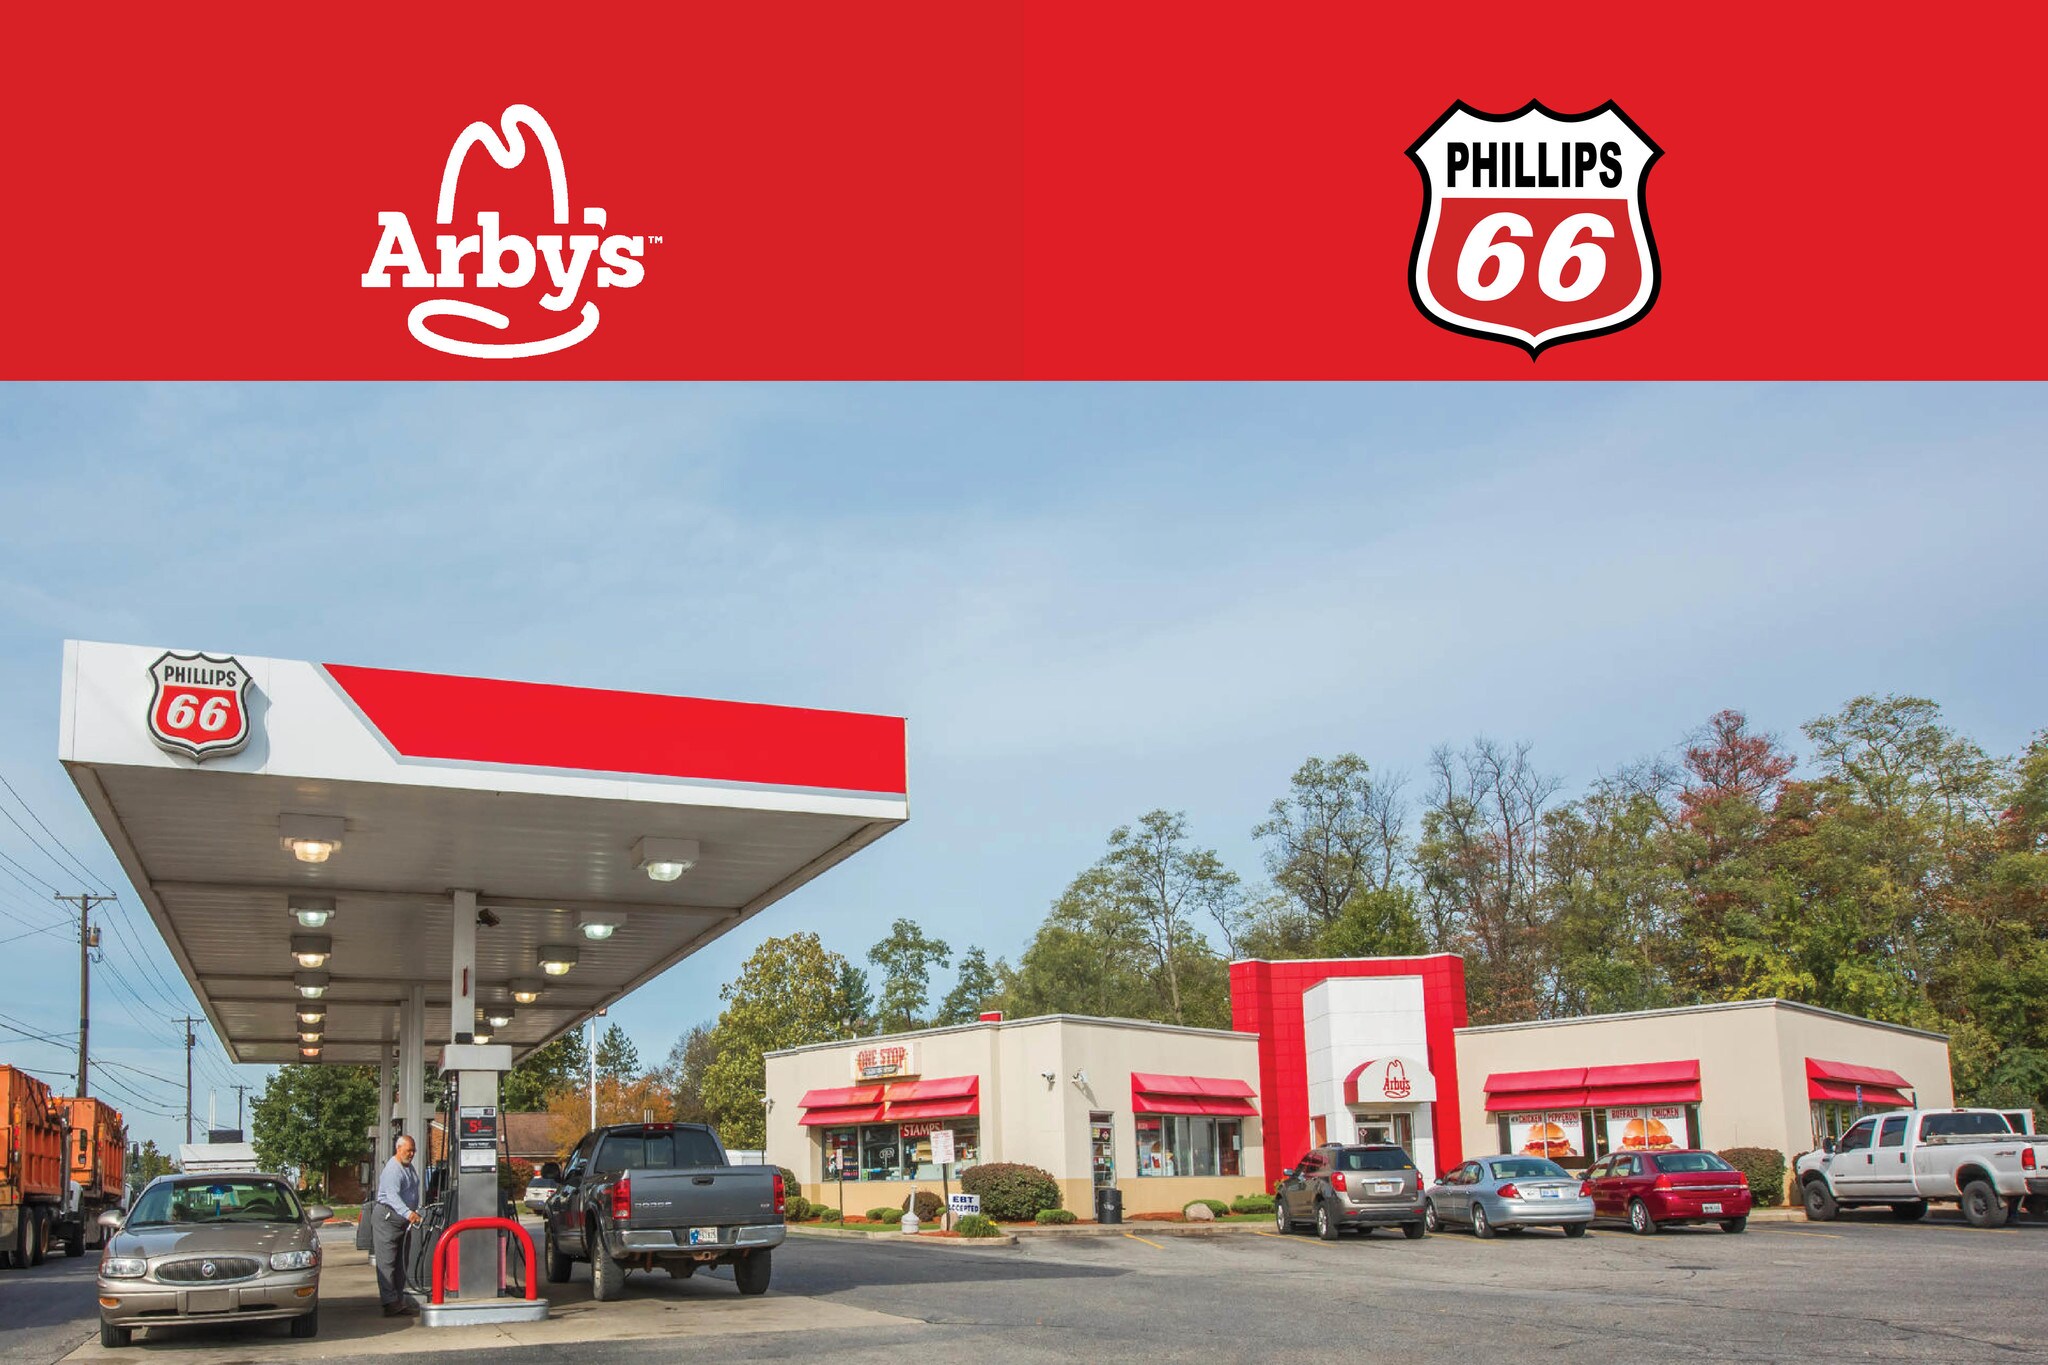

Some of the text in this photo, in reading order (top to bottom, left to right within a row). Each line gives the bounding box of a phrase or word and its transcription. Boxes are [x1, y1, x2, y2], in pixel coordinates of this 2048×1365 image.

[164, 665, 237, 688] PHILLIPS
[166, 693, 231, 732] 66
[858, 1046, 905, 1072] ONE STOP
[1383, 1076, 1411, 1094] Arby's
[1611, 1107, 1679, 1119] BUFFALO CHICKEN
[953, 1195, 974, 1203] EBT
